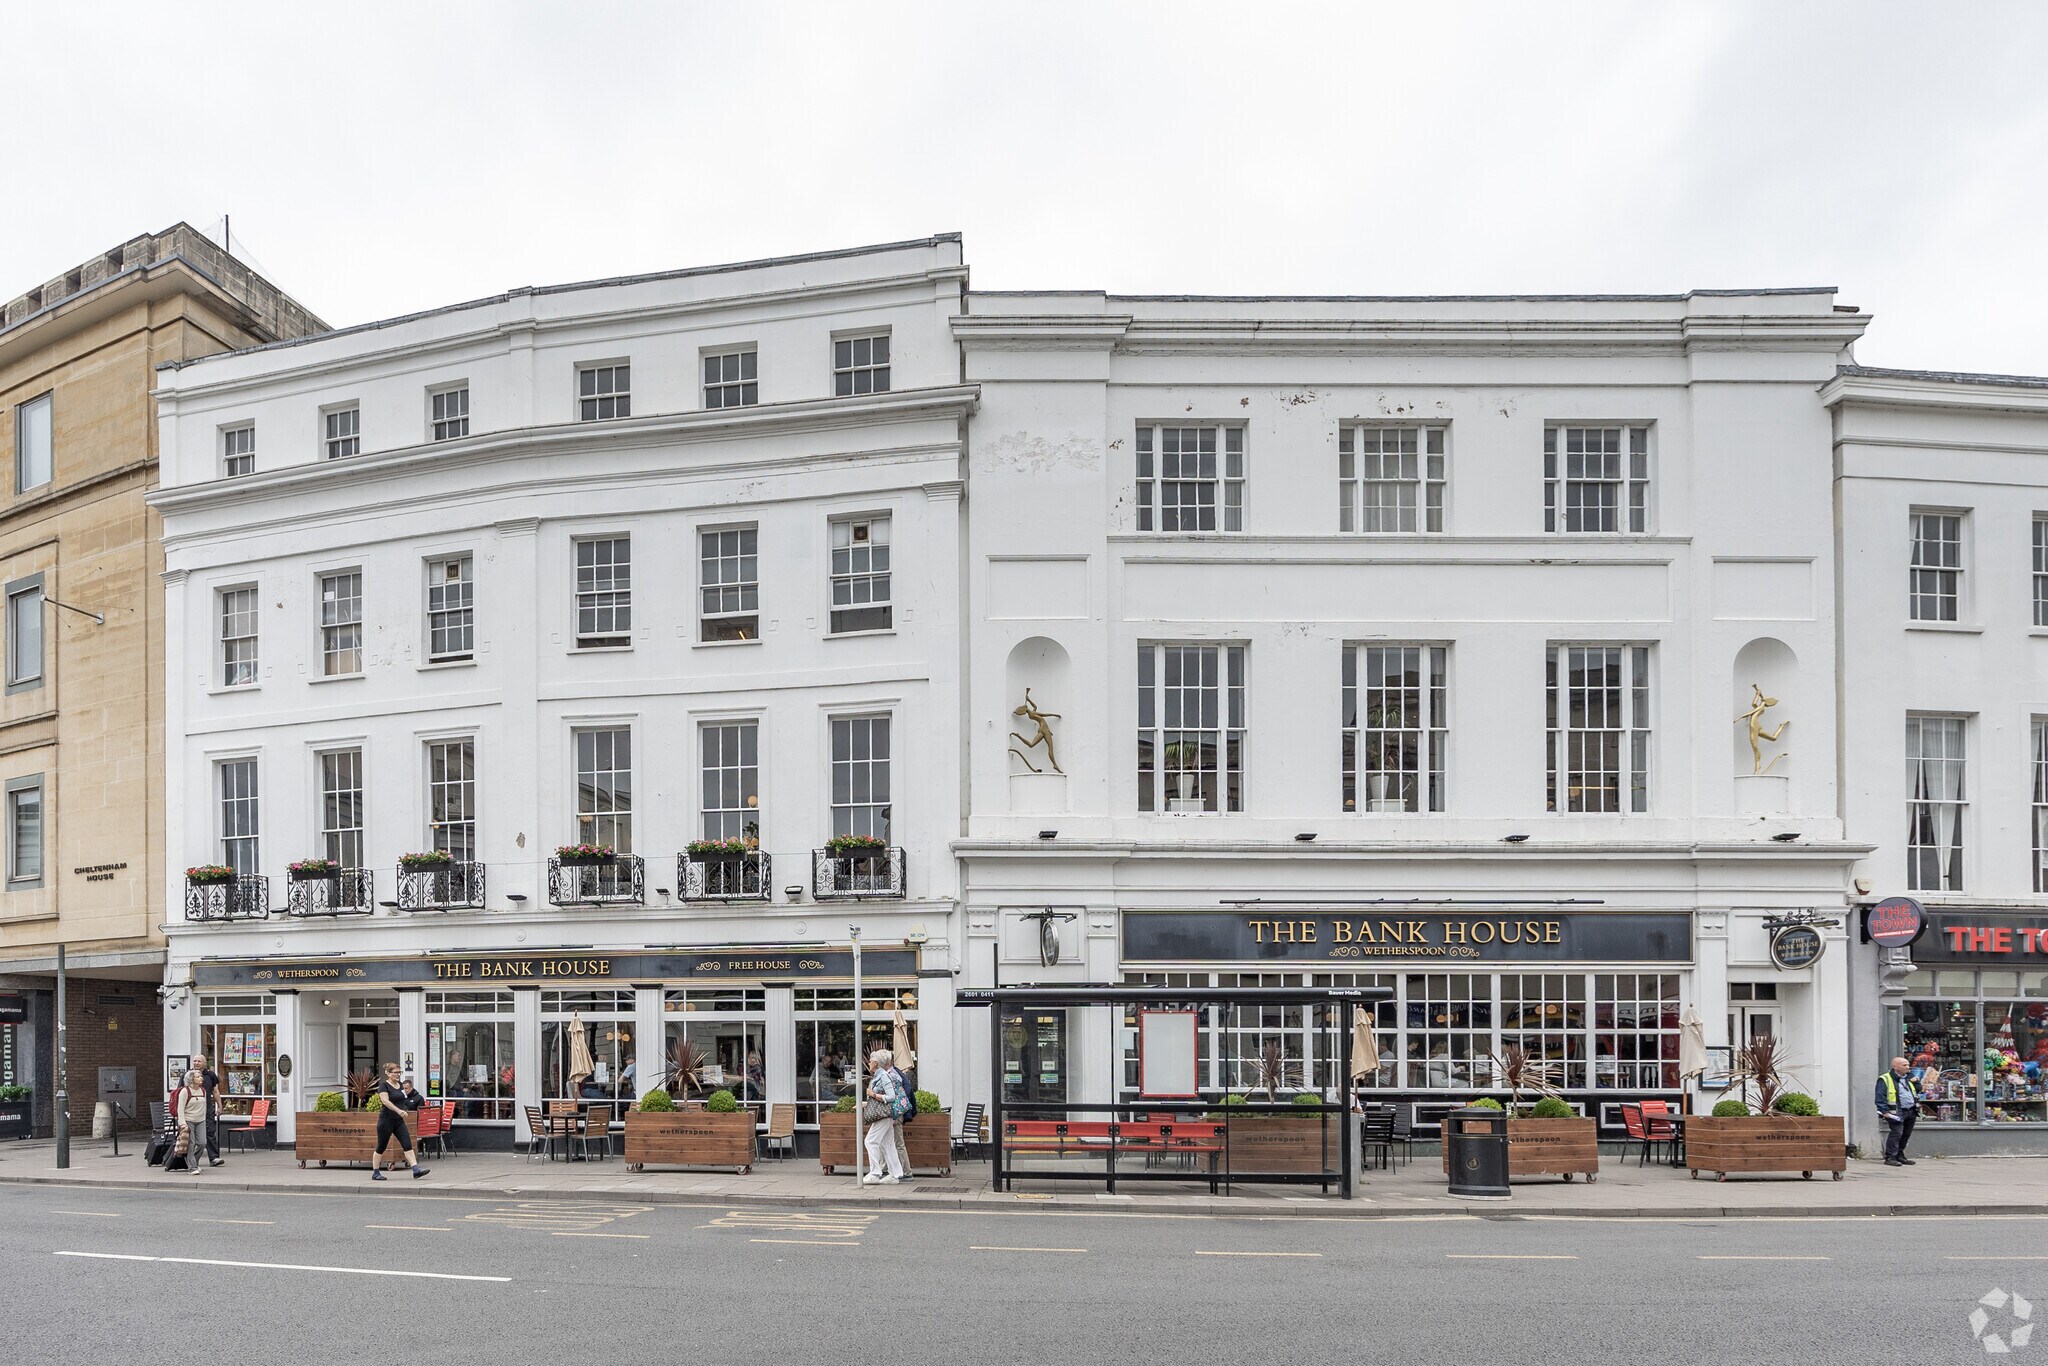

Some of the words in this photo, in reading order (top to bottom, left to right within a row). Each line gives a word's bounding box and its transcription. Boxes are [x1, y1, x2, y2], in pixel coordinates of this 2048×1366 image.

[74, 862, 127, 874] CHELTENHAM
[86, 873, 114, 881] HOUSE
[1876, 904, 1911, 919] THE
[1872, 915, 1917, 931] TOWN
[1248, 920, 1318, 943] THE
[1332, 921, 1429, 943] BANK
[1443, 920, 1561, 944] HOUSE
[1944, 926, 2013, 952] THE
[1363, 946, 1447, 957] WETHERSPOON
[433, 963, 472, 977] THE
[480, 962, 534, 977] BANK
[541, 960, 610, 975] HOUSE
[728, 962, 753, 970] FREE
[756, 961, 791, 970] HOUSE
[277, 968, 339, 978] WETHERSPOON
